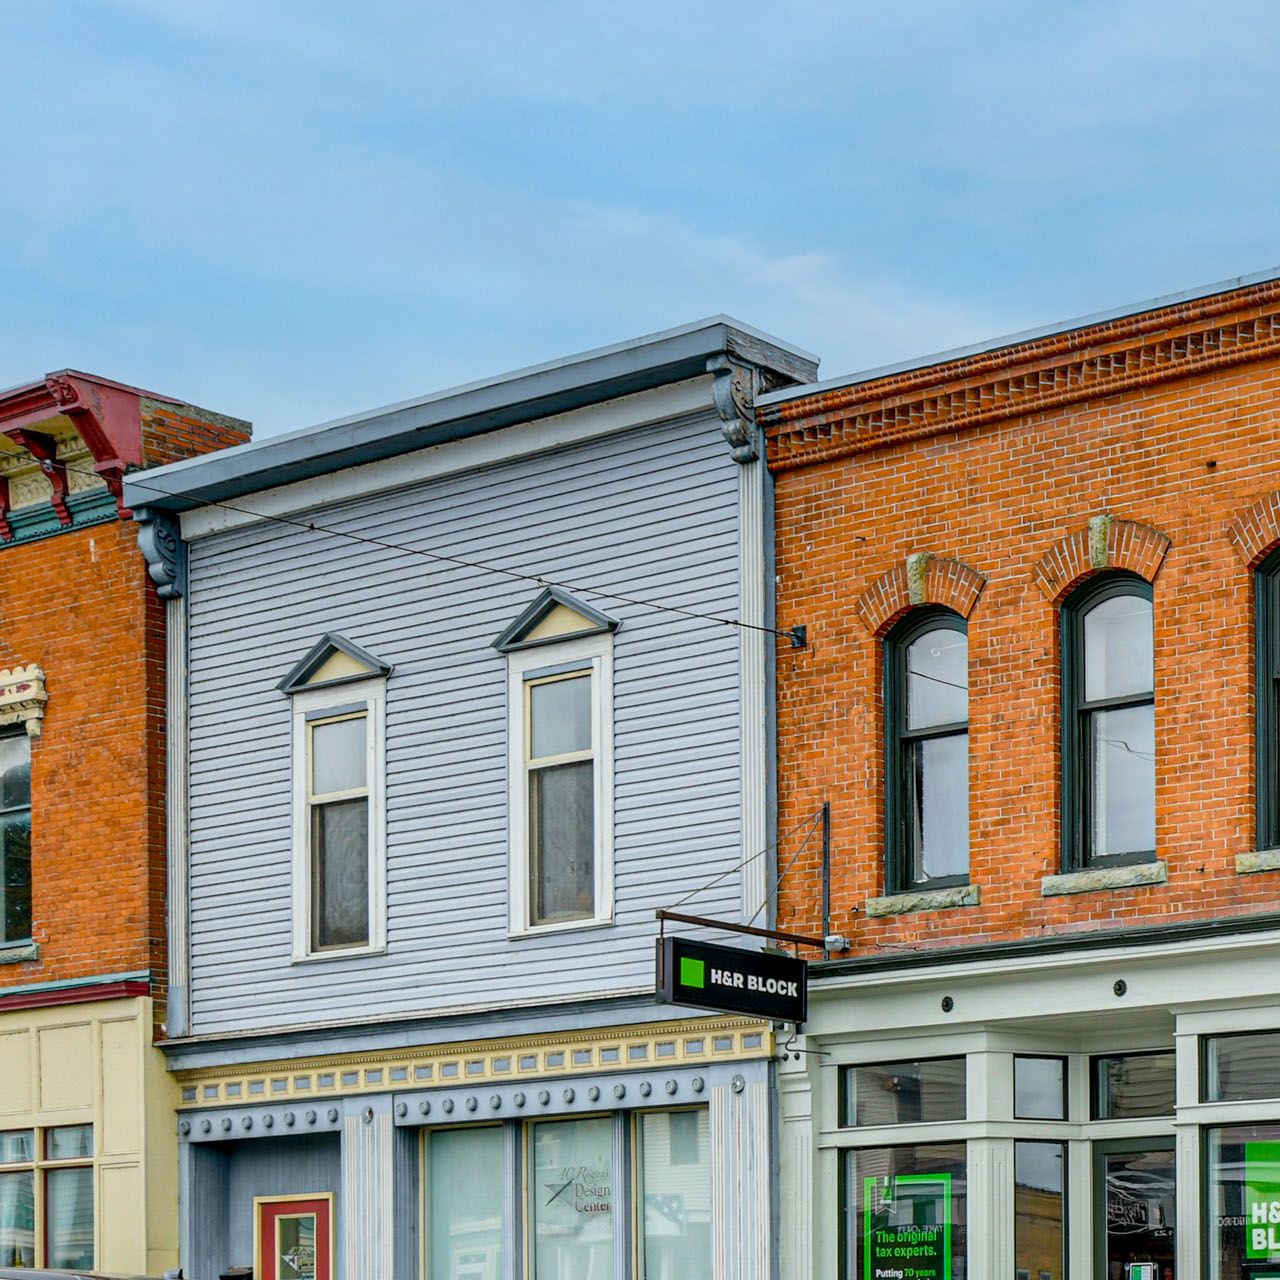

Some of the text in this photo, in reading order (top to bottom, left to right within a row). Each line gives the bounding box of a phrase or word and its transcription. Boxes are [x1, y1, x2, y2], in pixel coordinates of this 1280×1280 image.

[711, 969, 798, 997] H&R BLOCK
[575, 1183, 611, 1198] Design
[575, 1198, 609, 1212] Center
[876, 1230, 937, 1244] The original
[876, 1246, 937, 1259] tax experts.
[876, 1268, 936, 1279] Putting 70 years
